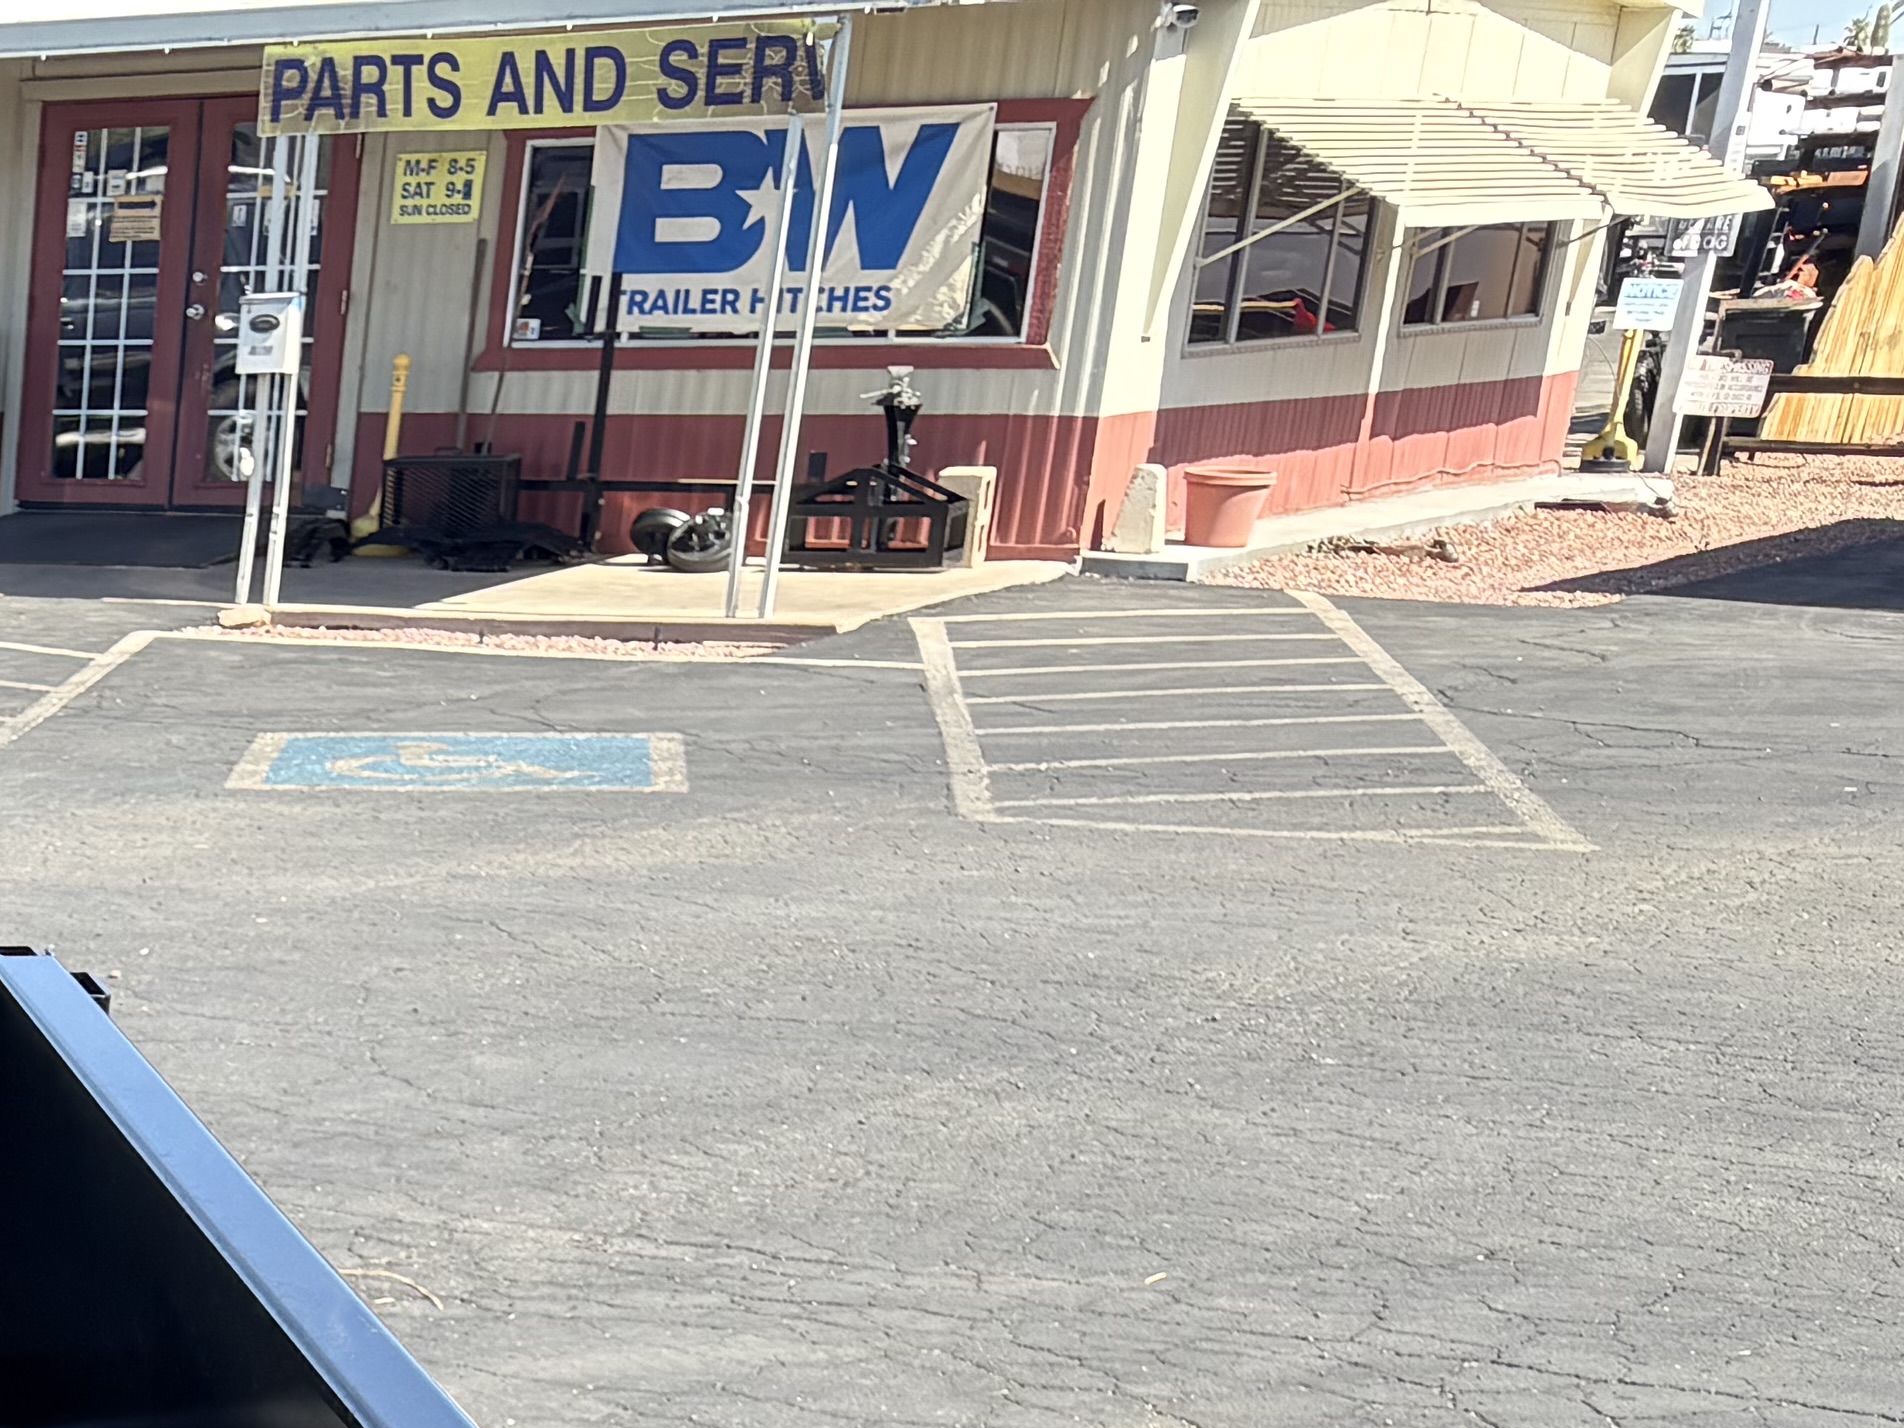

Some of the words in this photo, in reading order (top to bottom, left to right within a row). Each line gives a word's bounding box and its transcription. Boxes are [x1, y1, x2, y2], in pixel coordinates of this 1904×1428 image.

[270, 51, 462, 123] PARTS
[486, 46, 627, 116] AND
[404, 159, 439, 176] M-F
[447, 158, 476, 175] 8-5
[401, 182, 435, 199] SAT
[445, 180, 473, 200] 9-
[399, 205, 423, 216] SUN
[426, 203, 472, 215] CLOSED
[620, 288, 741, 316] RAILER
[749, 285, 893, 314] HITHES
